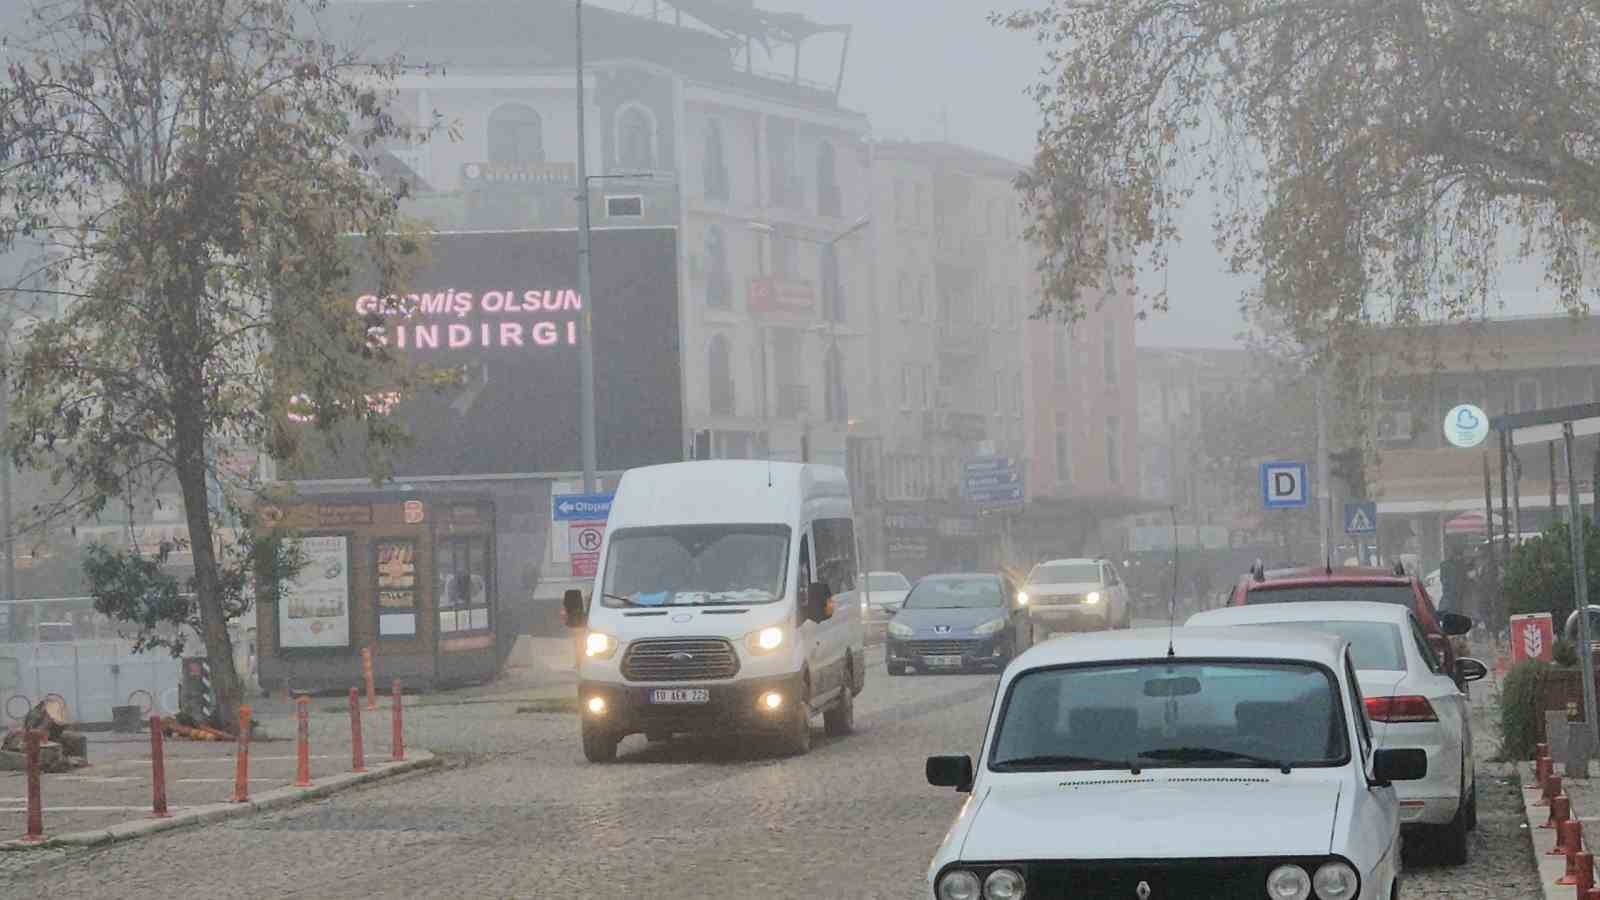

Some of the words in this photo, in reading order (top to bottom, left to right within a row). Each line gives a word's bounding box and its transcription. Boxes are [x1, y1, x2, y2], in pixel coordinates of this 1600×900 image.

[356, 288, 472, 317] GEÇMİŞ
[480, 289, 582, 312] OLSUN
[366, 321, 577, 348] SINDIRGI
[1275, 472, 1295, 496] D
